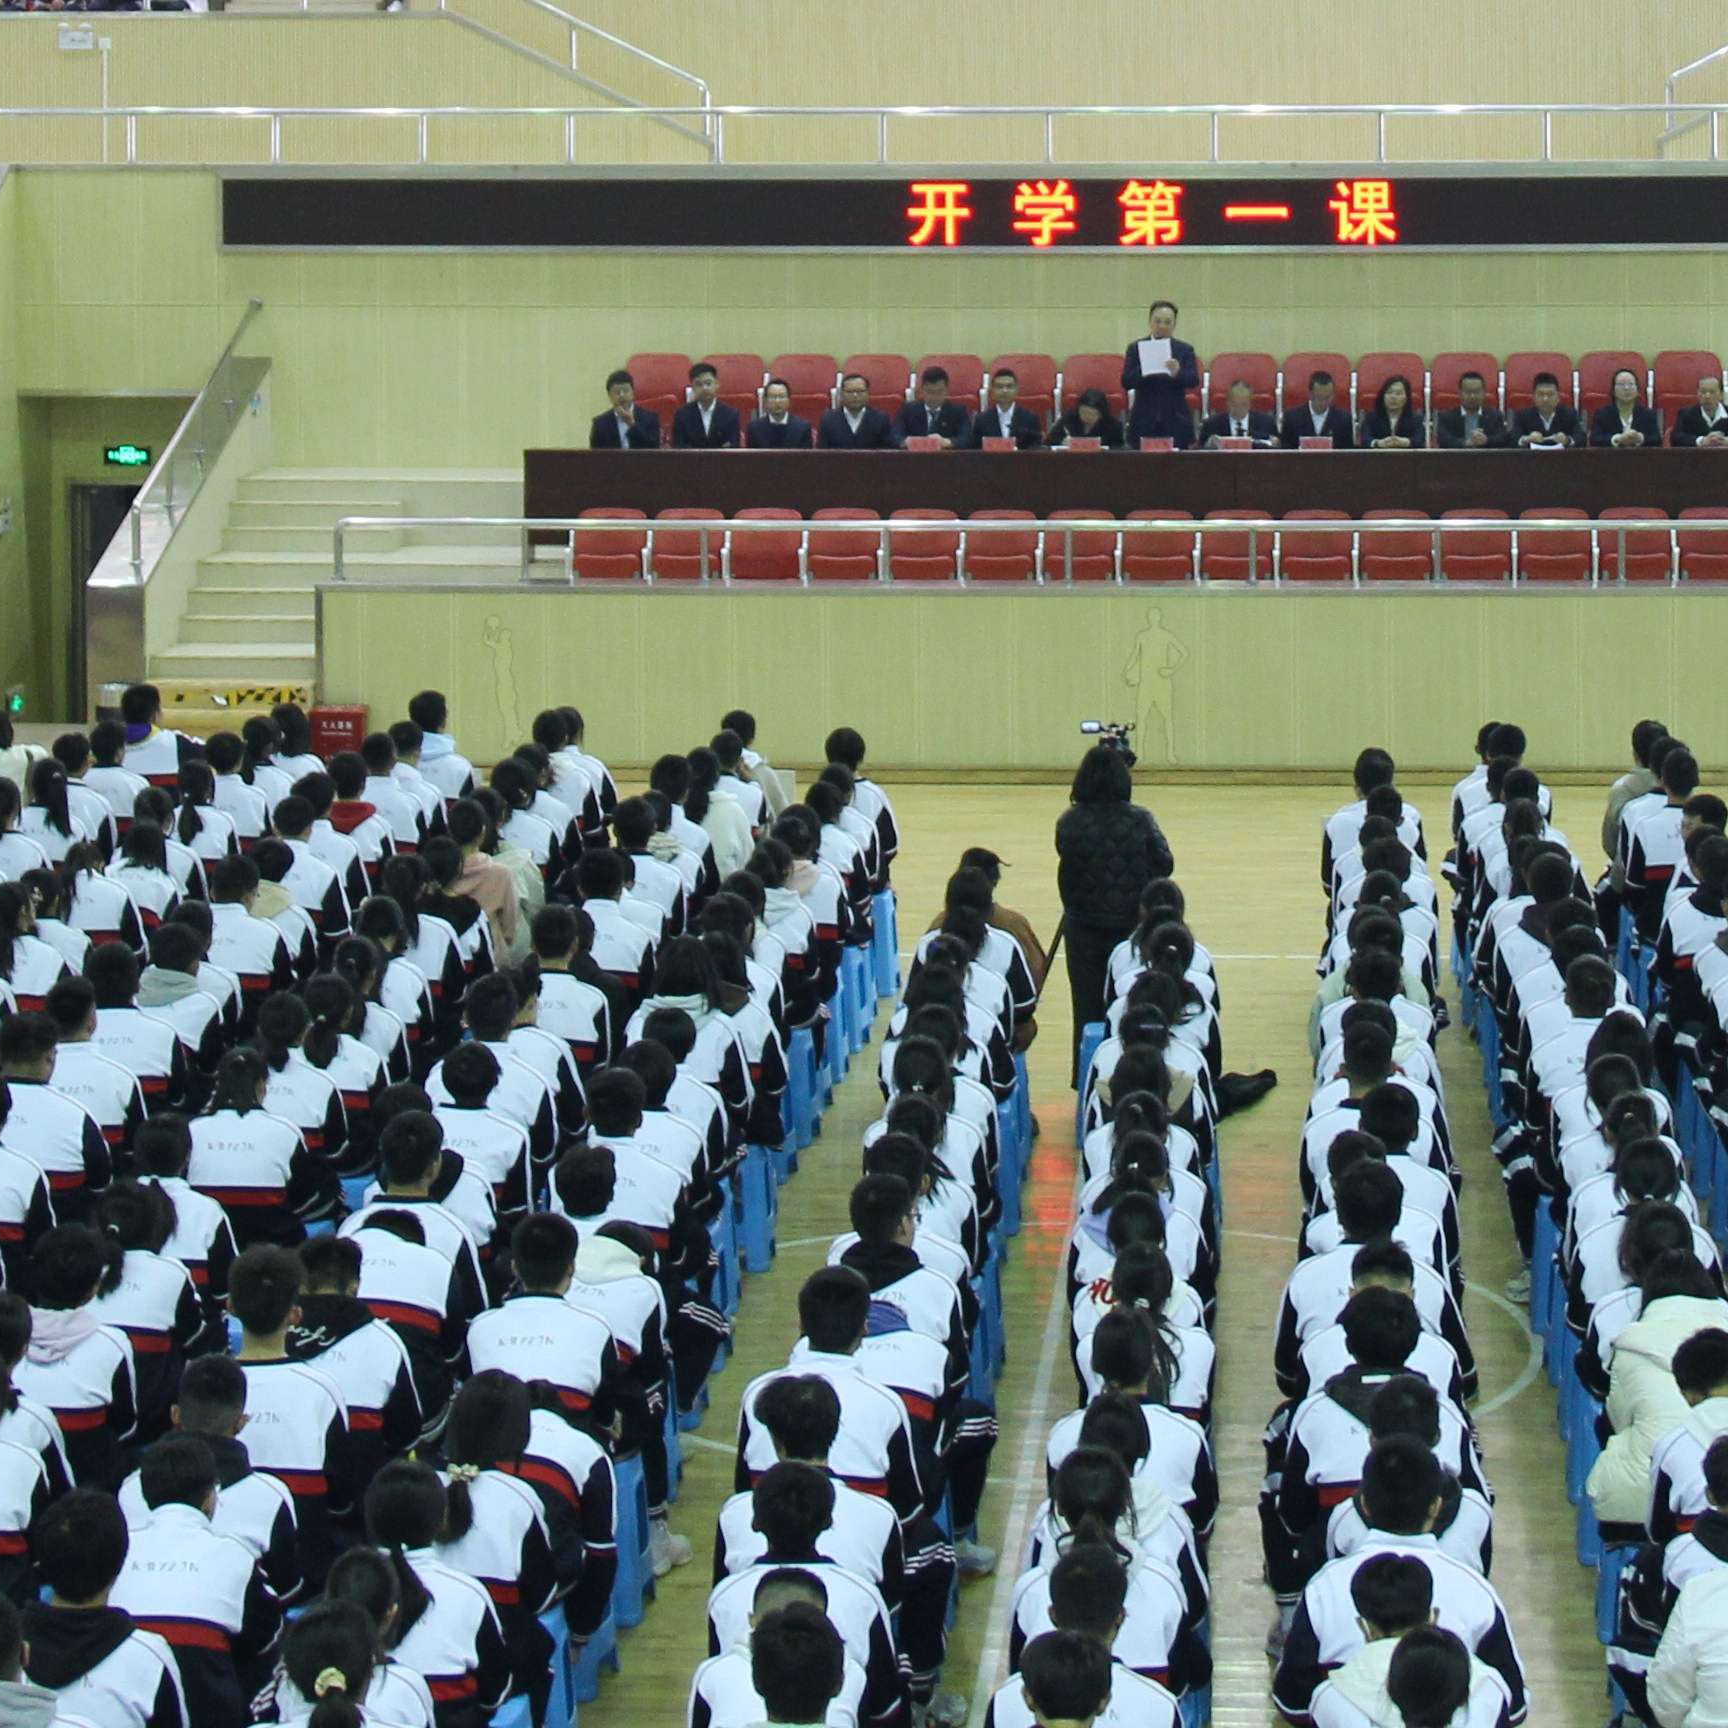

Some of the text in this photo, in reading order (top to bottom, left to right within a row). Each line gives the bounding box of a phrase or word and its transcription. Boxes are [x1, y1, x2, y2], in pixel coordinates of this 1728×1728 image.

[906, 179, 1398, 247] 开学第一课
